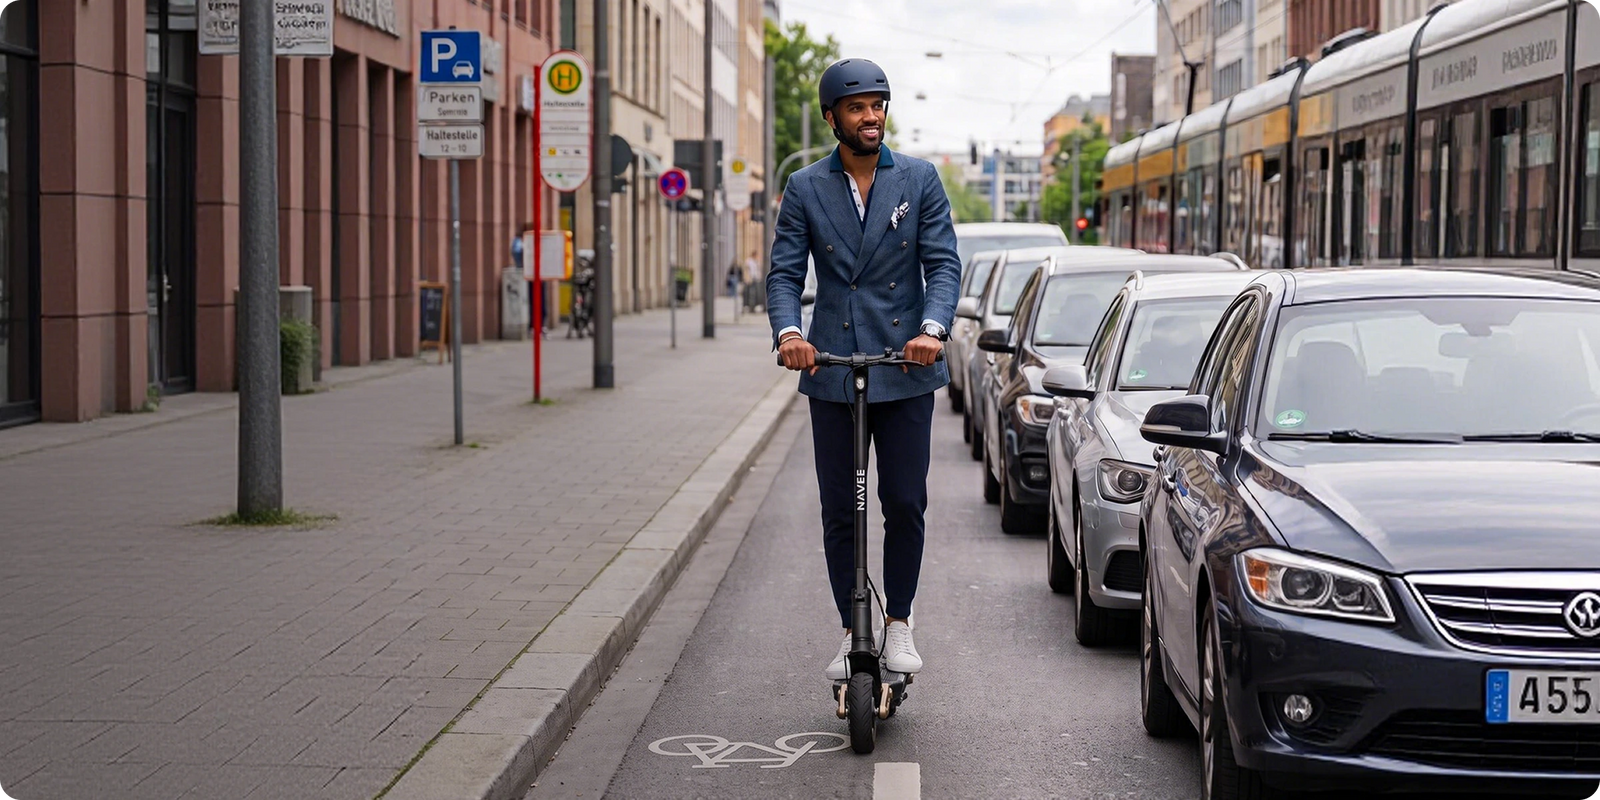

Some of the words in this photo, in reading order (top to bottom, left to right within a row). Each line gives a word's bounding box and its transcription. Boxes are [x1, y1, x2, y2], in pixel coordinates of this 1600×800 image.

[431, 37, 457, 73] P
[557, 67, 573, 86] H
[429, 91, 475, 103] Parken
[426, 129, 478, 141] Haltestelle
[857, 469, 865, 510] NAVEE
[1519, 676, 1600, 714] A55
